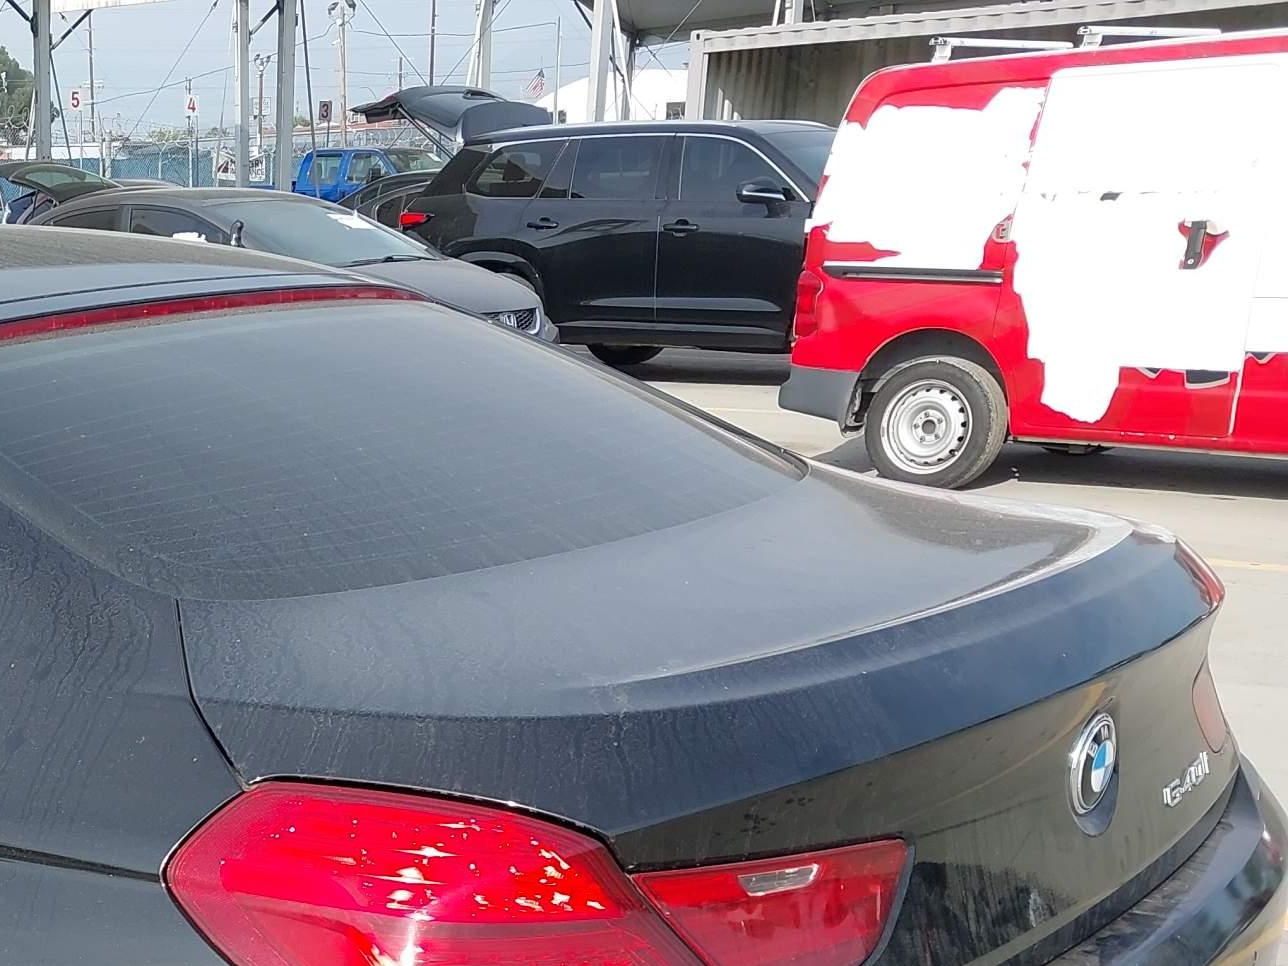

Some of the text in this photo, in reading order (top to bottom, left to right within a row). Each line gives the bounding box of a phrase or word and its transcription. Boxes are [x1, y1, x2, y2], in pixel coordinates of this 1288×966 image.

[71, 91, 80, 108] 5
[187, 97, 196, 112] 4
[321, 103, 329, 119] 3
